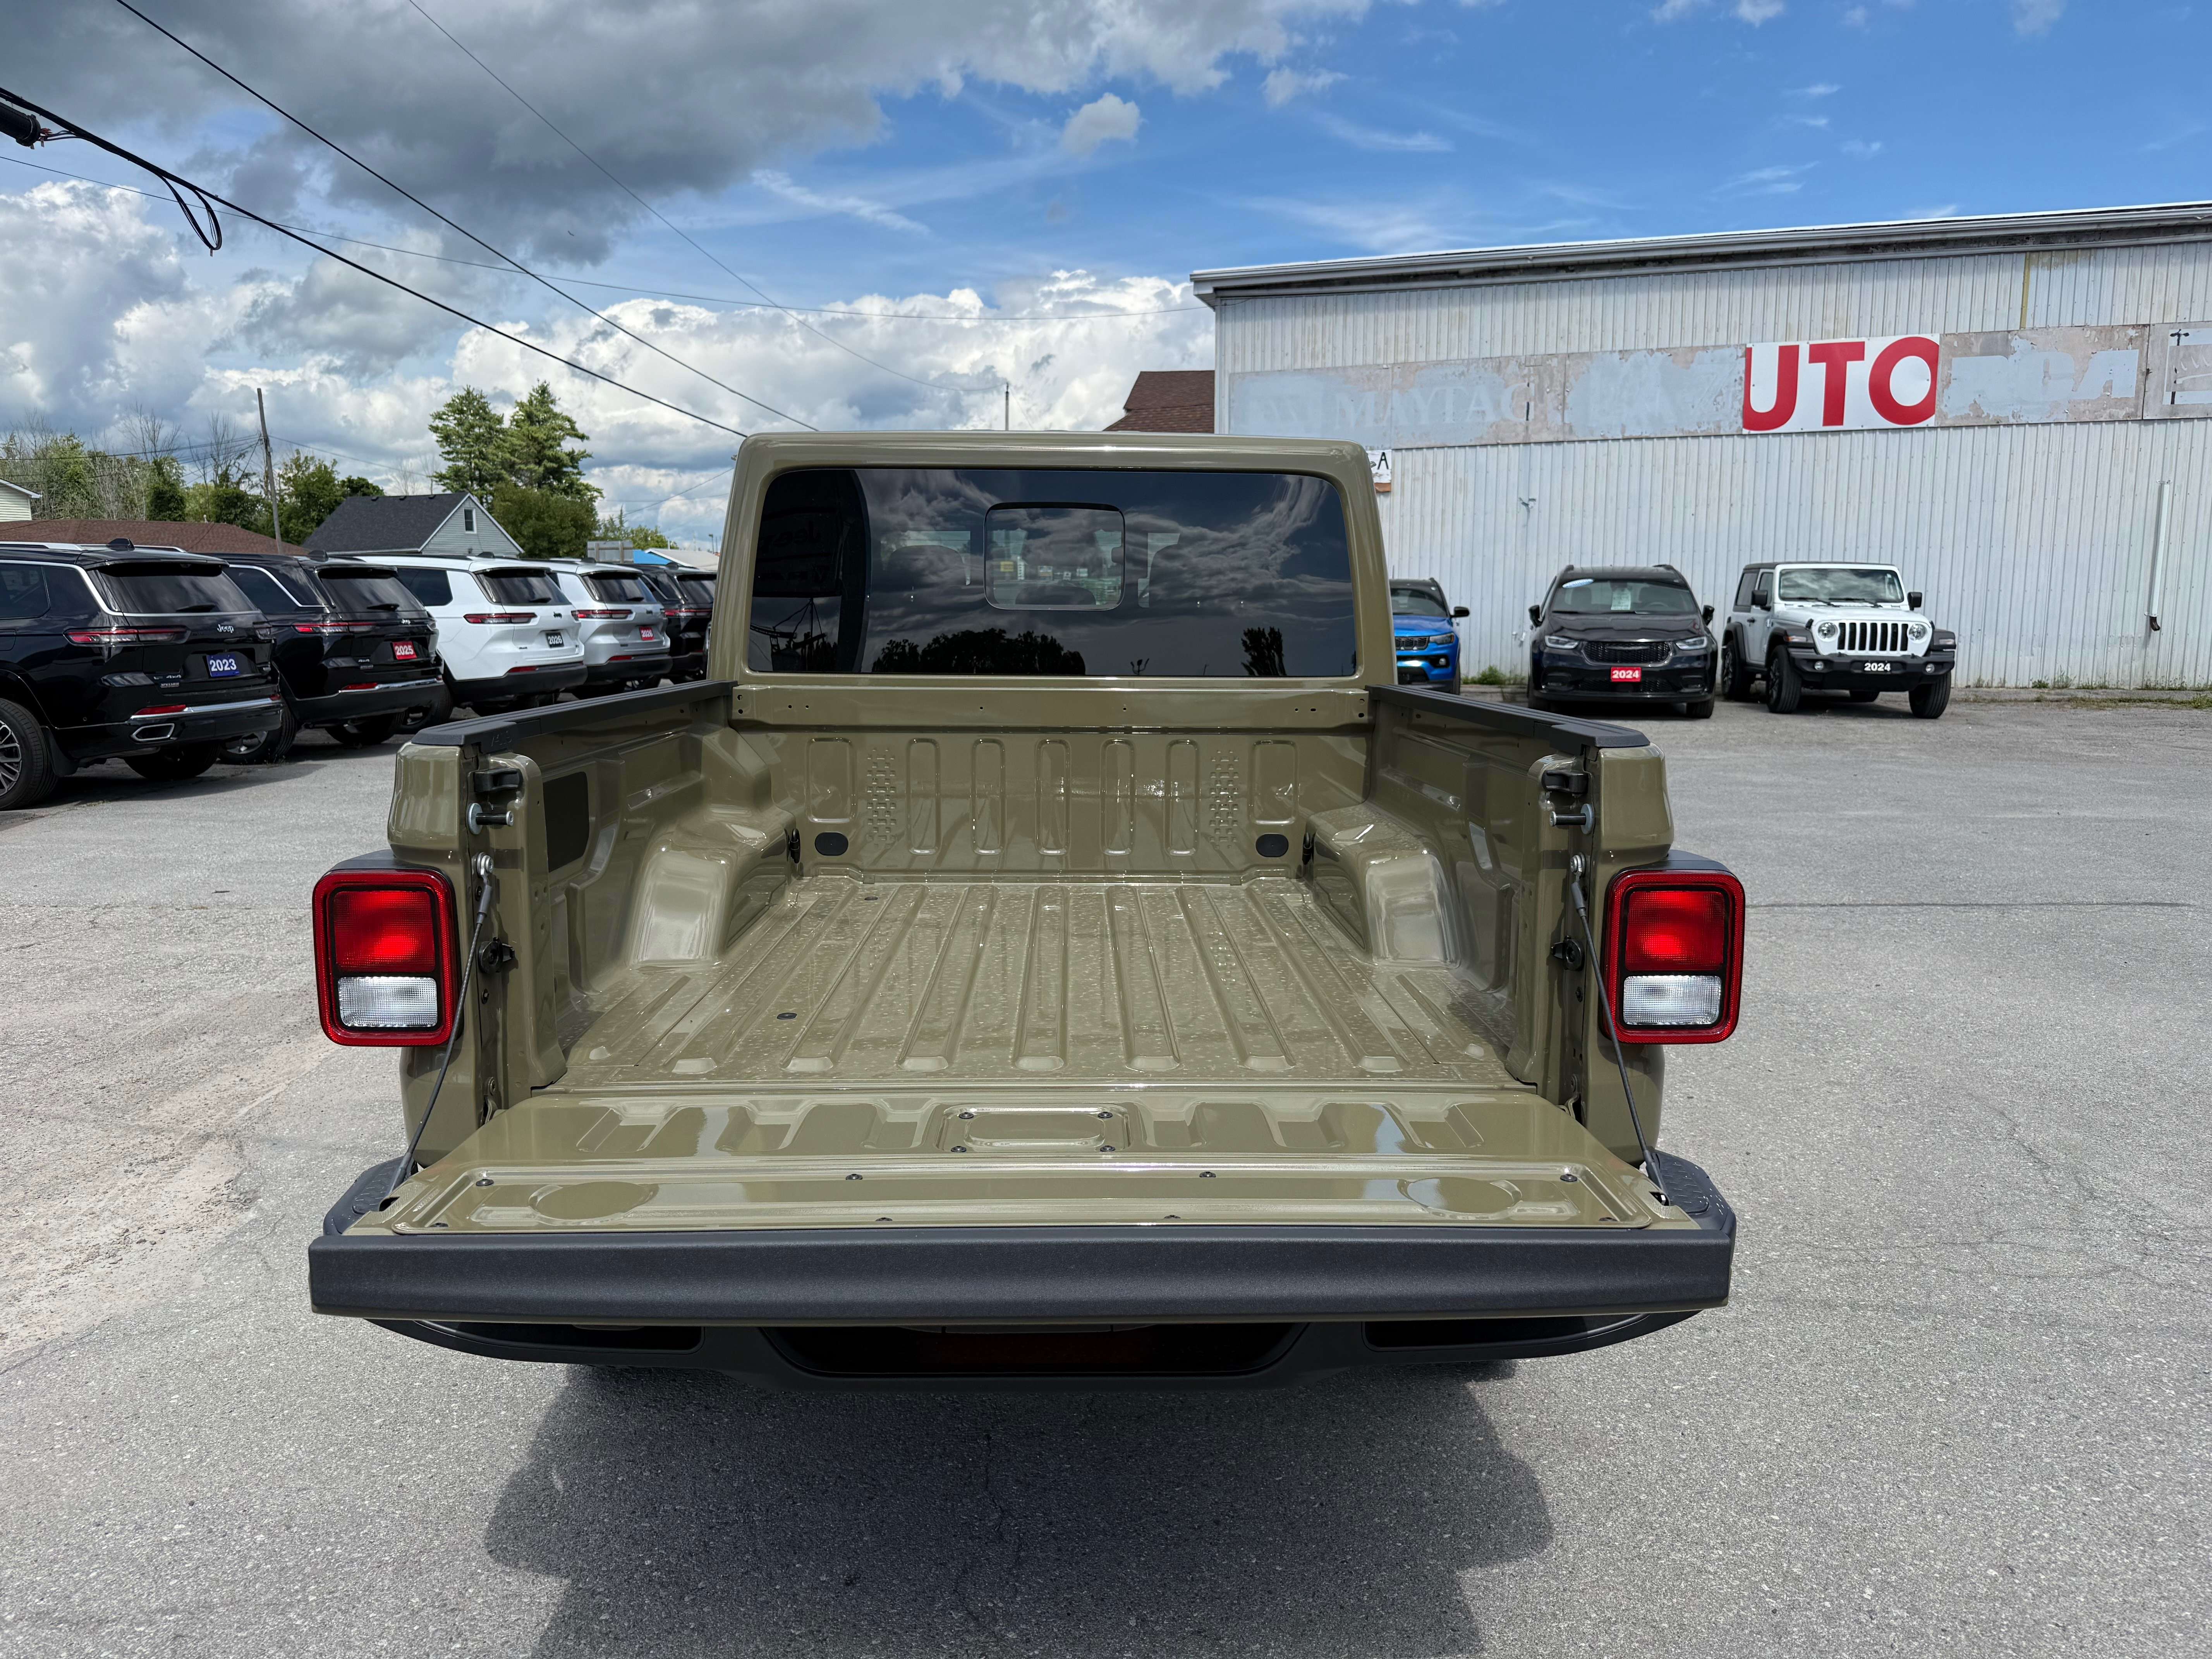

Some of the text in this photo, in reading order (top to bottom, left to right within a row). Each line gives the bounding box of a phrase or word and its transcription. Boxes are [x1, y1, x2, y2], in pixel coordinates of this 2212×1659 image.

[1743, 337, 1939, 431] UTO
[217, 624, 234, 633] Jeep
[395, 645, 414, 655] 2025
[210, 659, 237, 672] 2023
[1864, 663, 1891, 672] 2024
[1612, 670, 1639, 679] 2024
